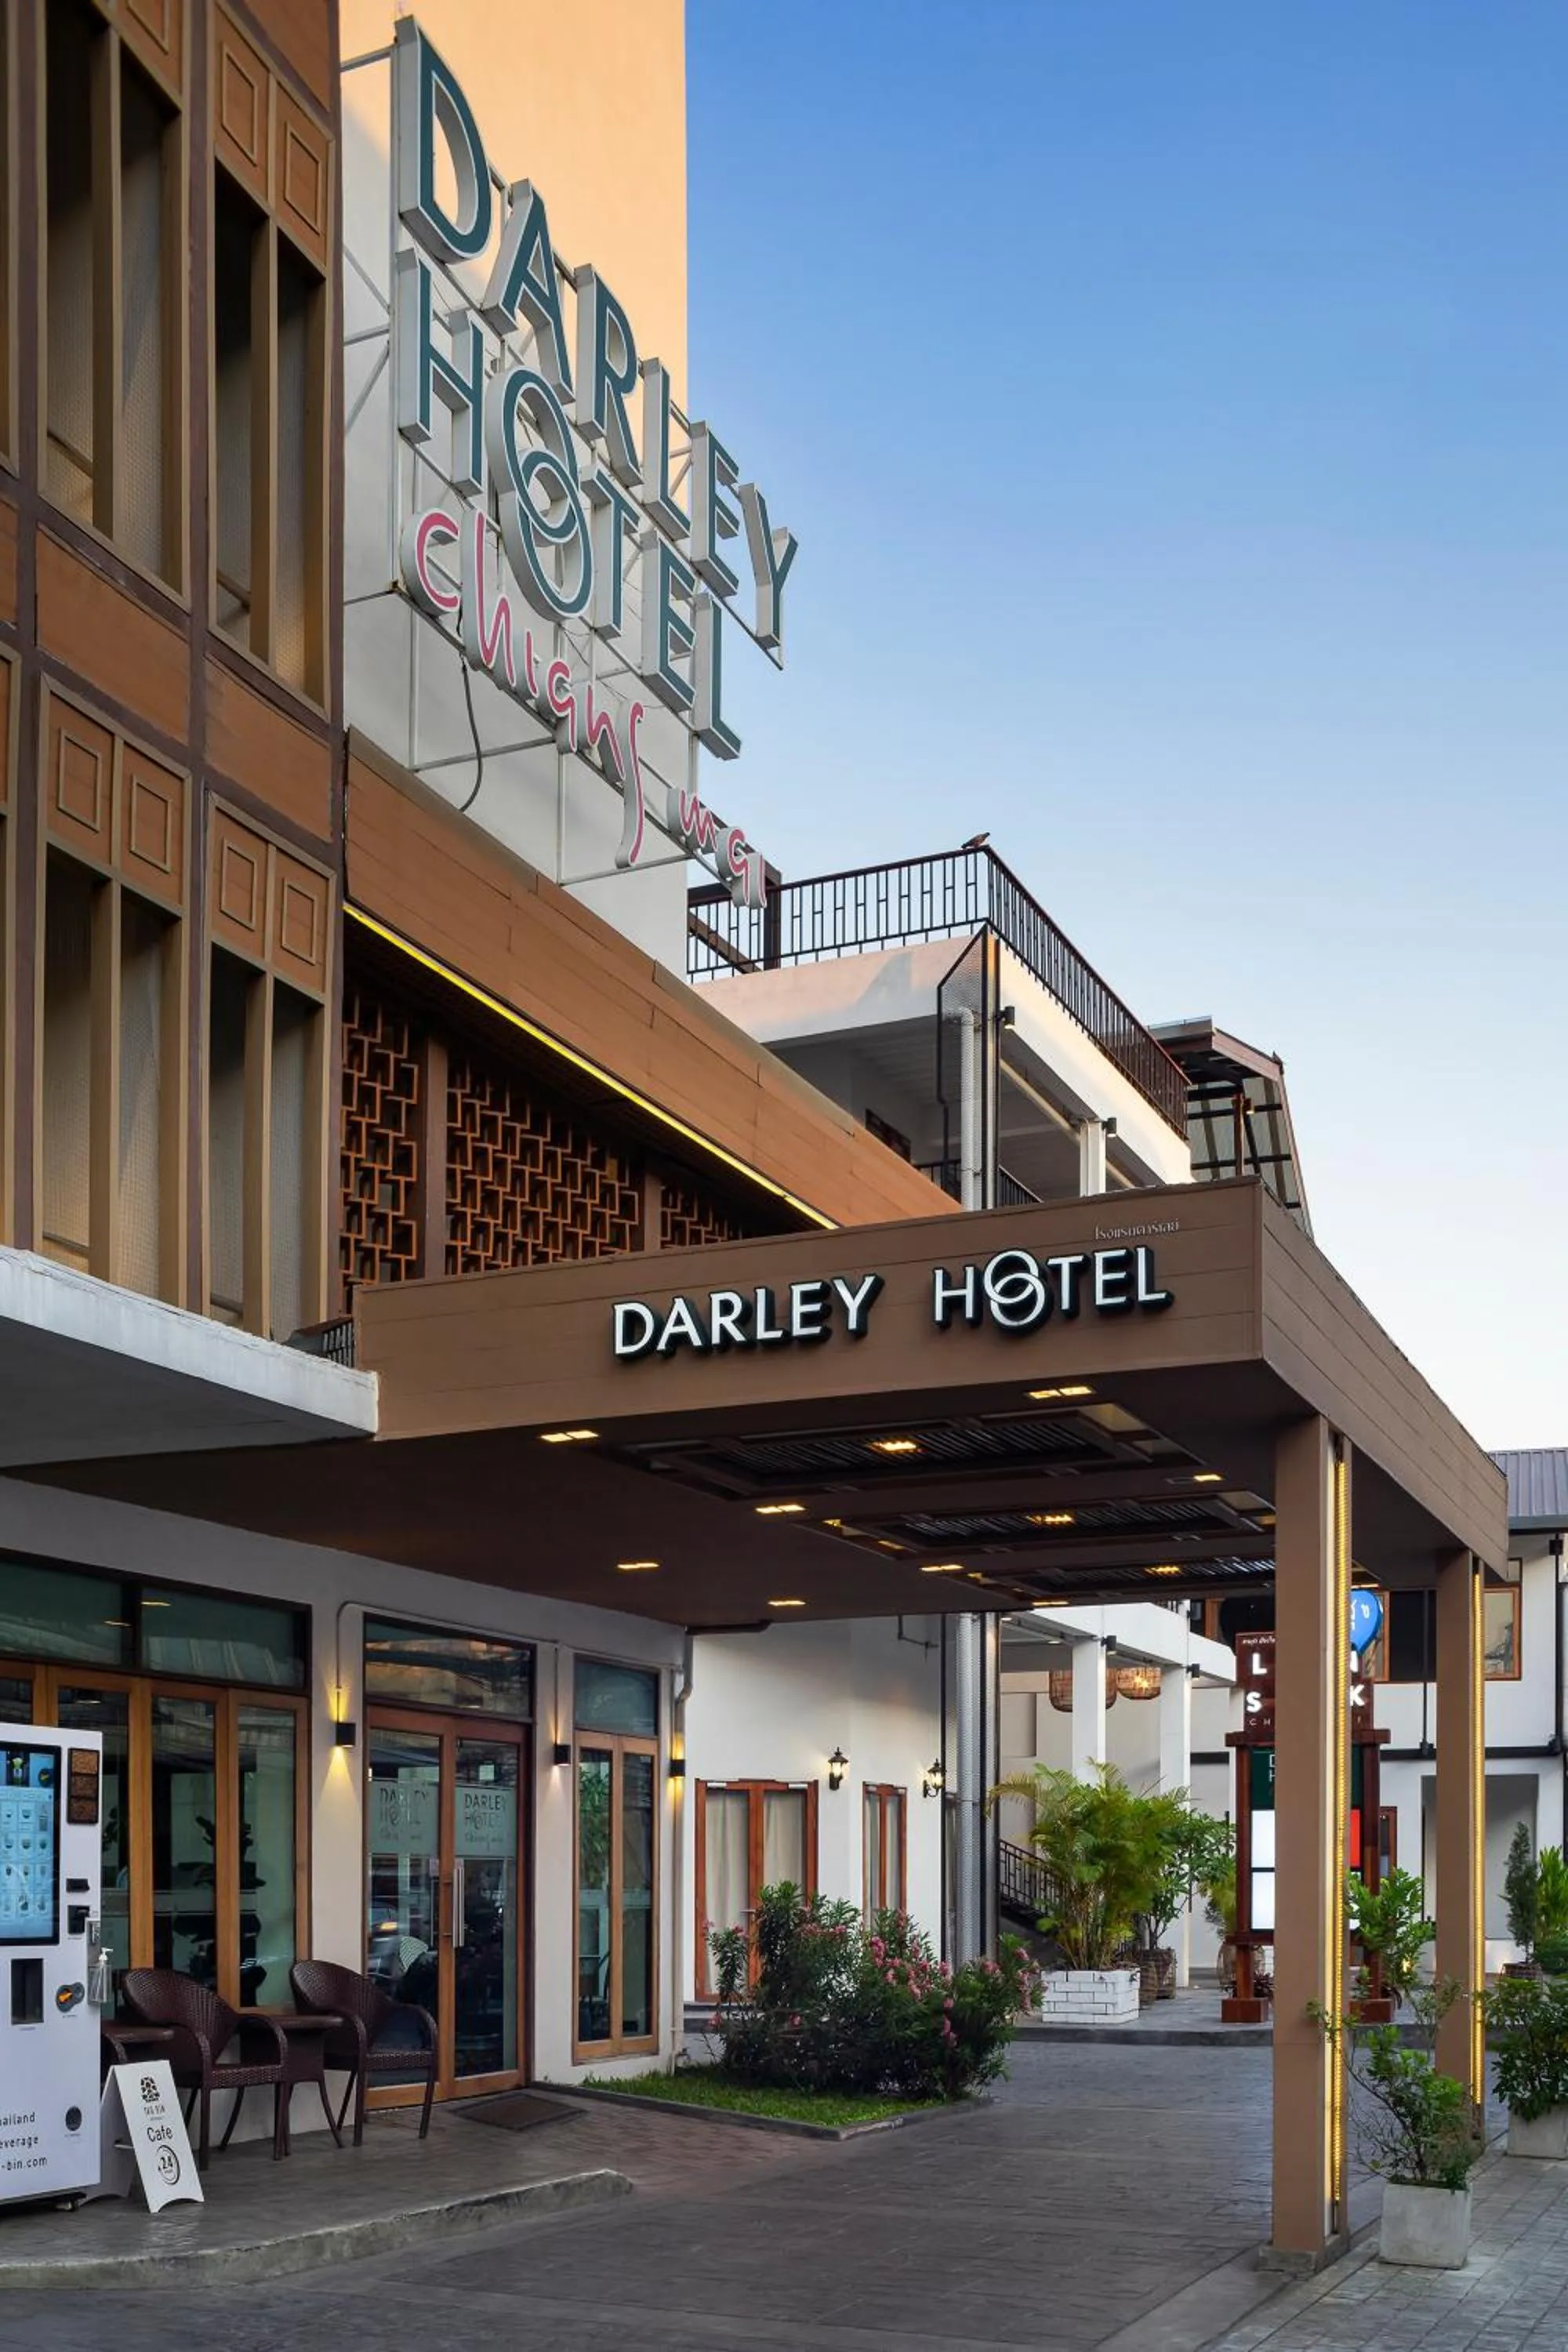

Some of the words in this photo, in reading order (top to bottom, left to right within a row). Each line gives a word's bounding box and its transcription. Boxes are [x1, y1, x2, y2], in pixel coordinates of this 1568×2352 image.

[396, 15, 799, 648] DARLEY
[395, 248, 742, 760] HOTEL
[612, 1273, 882, 1359] DARLEY
[932, 1247, 1171, 1334] HOTEL
[147, 2125, 173, 2142] Cafe
